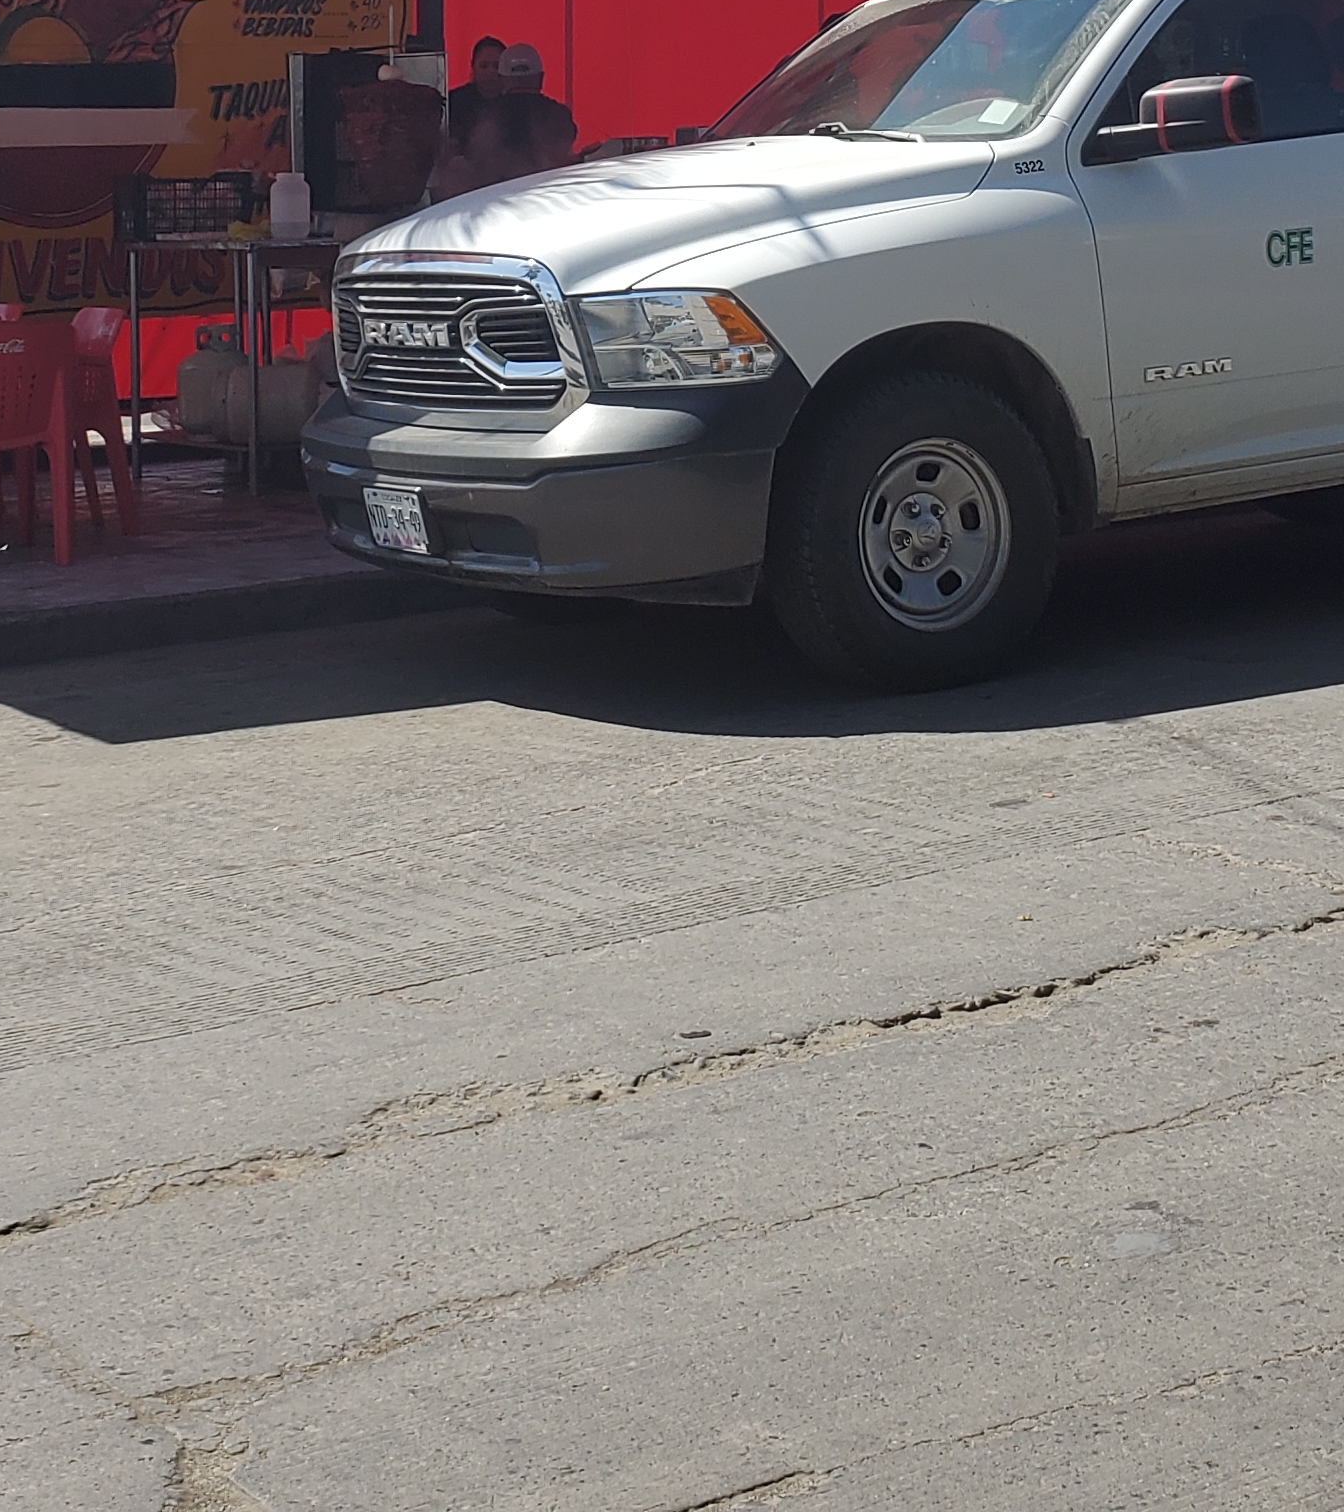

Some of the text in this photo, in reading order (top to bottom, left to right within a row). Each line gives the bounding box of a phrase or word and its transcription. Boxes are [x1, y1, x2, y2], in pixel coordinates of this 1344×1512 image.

[241, 17, 316, 38] BEBIDAS
[1014, 160, 1045, 175] 5322
[1265, 227, 1315, 267] CFE
[364, 319, 452, 348] RAM
[1143, 357, 1233, 383] RAM
